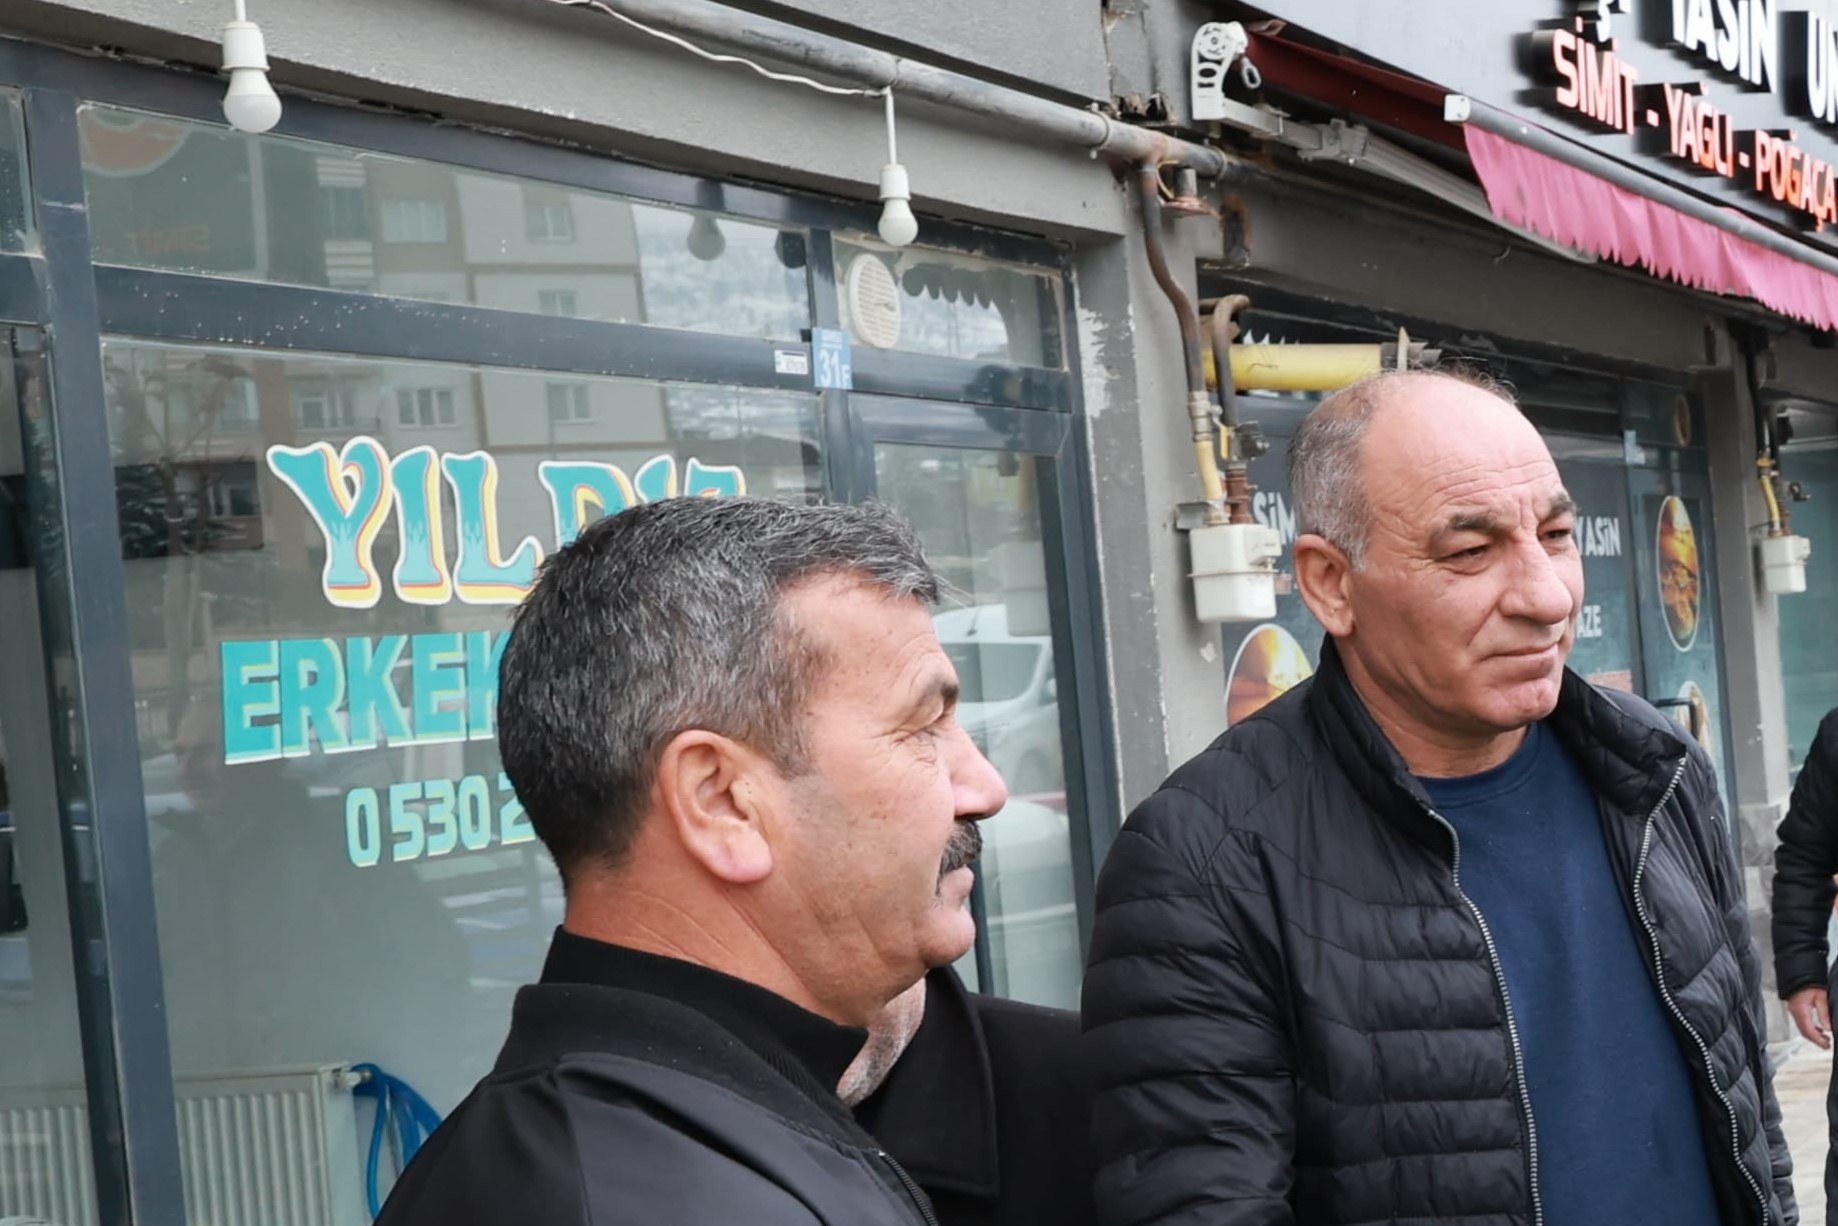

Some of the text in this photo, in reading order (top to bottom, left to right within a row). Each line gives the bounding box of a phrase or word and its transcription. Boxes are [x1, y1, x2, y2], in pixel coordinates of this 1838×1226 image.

[1553, 16, 1638, 135] SİMİT
[1663, 81, 1734, 178] YAĞLI
[1755, 129, 1838, 233] POĞAÇA
[1576, 604, 1603, 639] AZE
